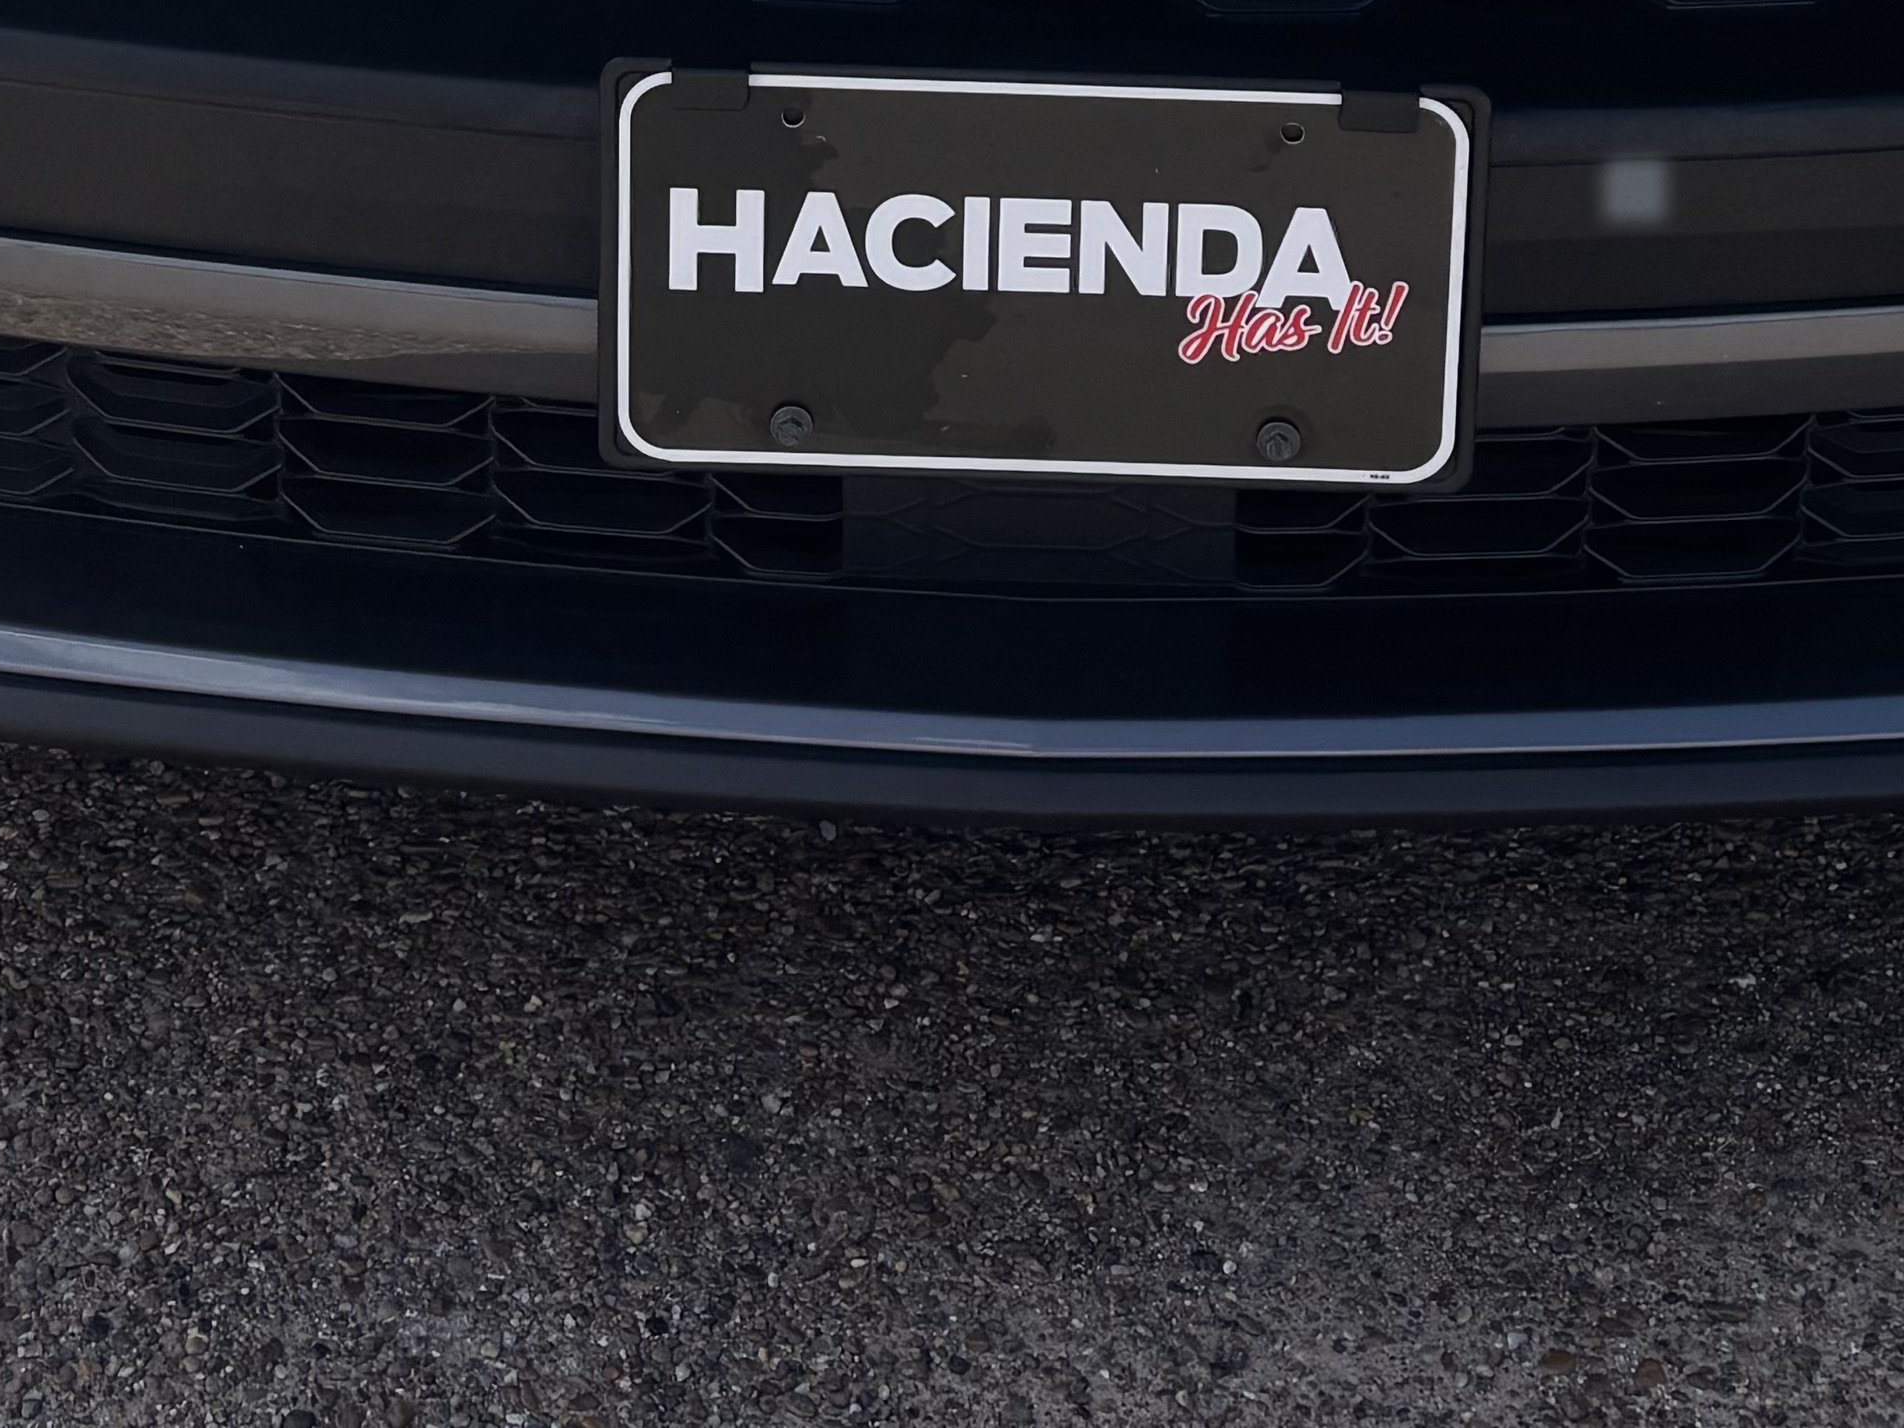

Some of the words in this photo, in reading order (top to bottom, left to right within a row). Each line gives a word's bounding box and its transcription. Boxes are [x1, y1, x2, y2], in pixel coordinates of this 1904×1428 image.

[668, 187, 1352, 310] HACIENDA
[1178, 291, 1322, 365] Has
[1327, 280, 1410, 355] It!
